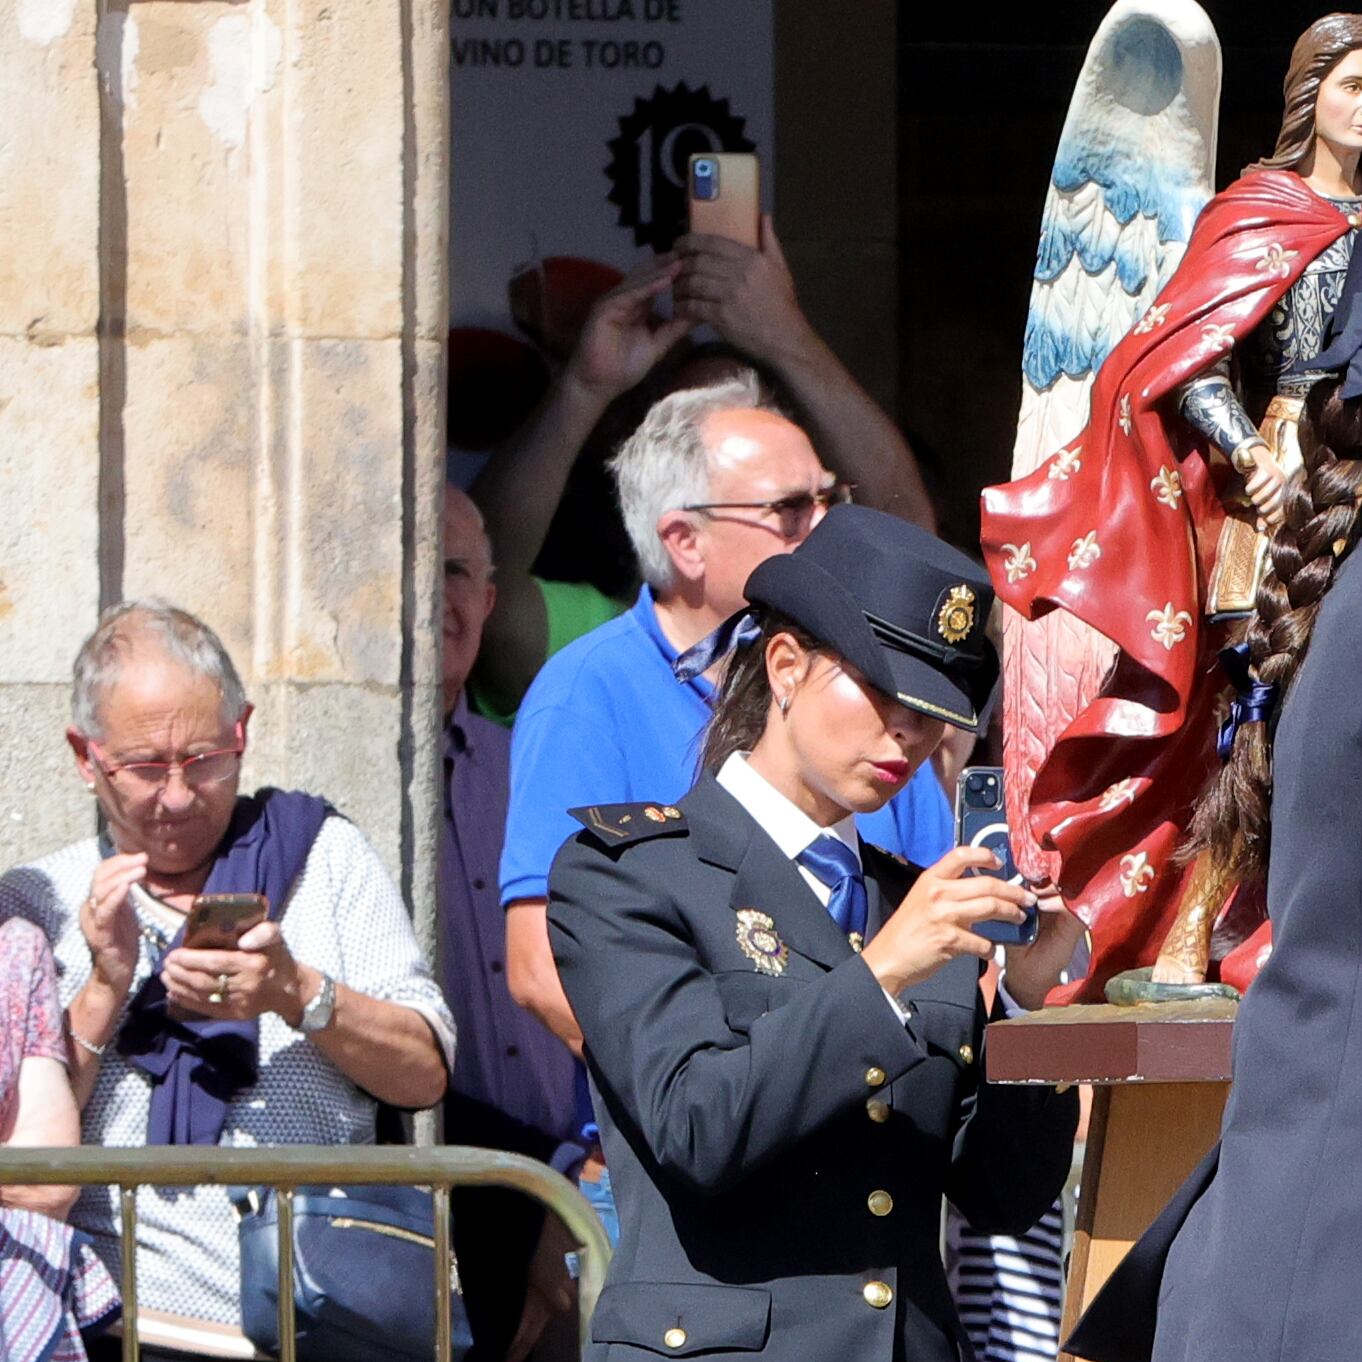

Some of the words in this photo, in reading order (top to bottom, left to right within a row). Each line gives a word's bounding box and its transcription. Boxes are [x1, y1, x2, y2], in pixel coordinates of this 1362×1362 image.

[508, 0, 635, 21] BOTELLA
[644, 0, 681, 22] DE
[452, 37, 525, 67] VINO
[534, 39, 572, 68] DE
[581, 40, 665, 69] TORO
